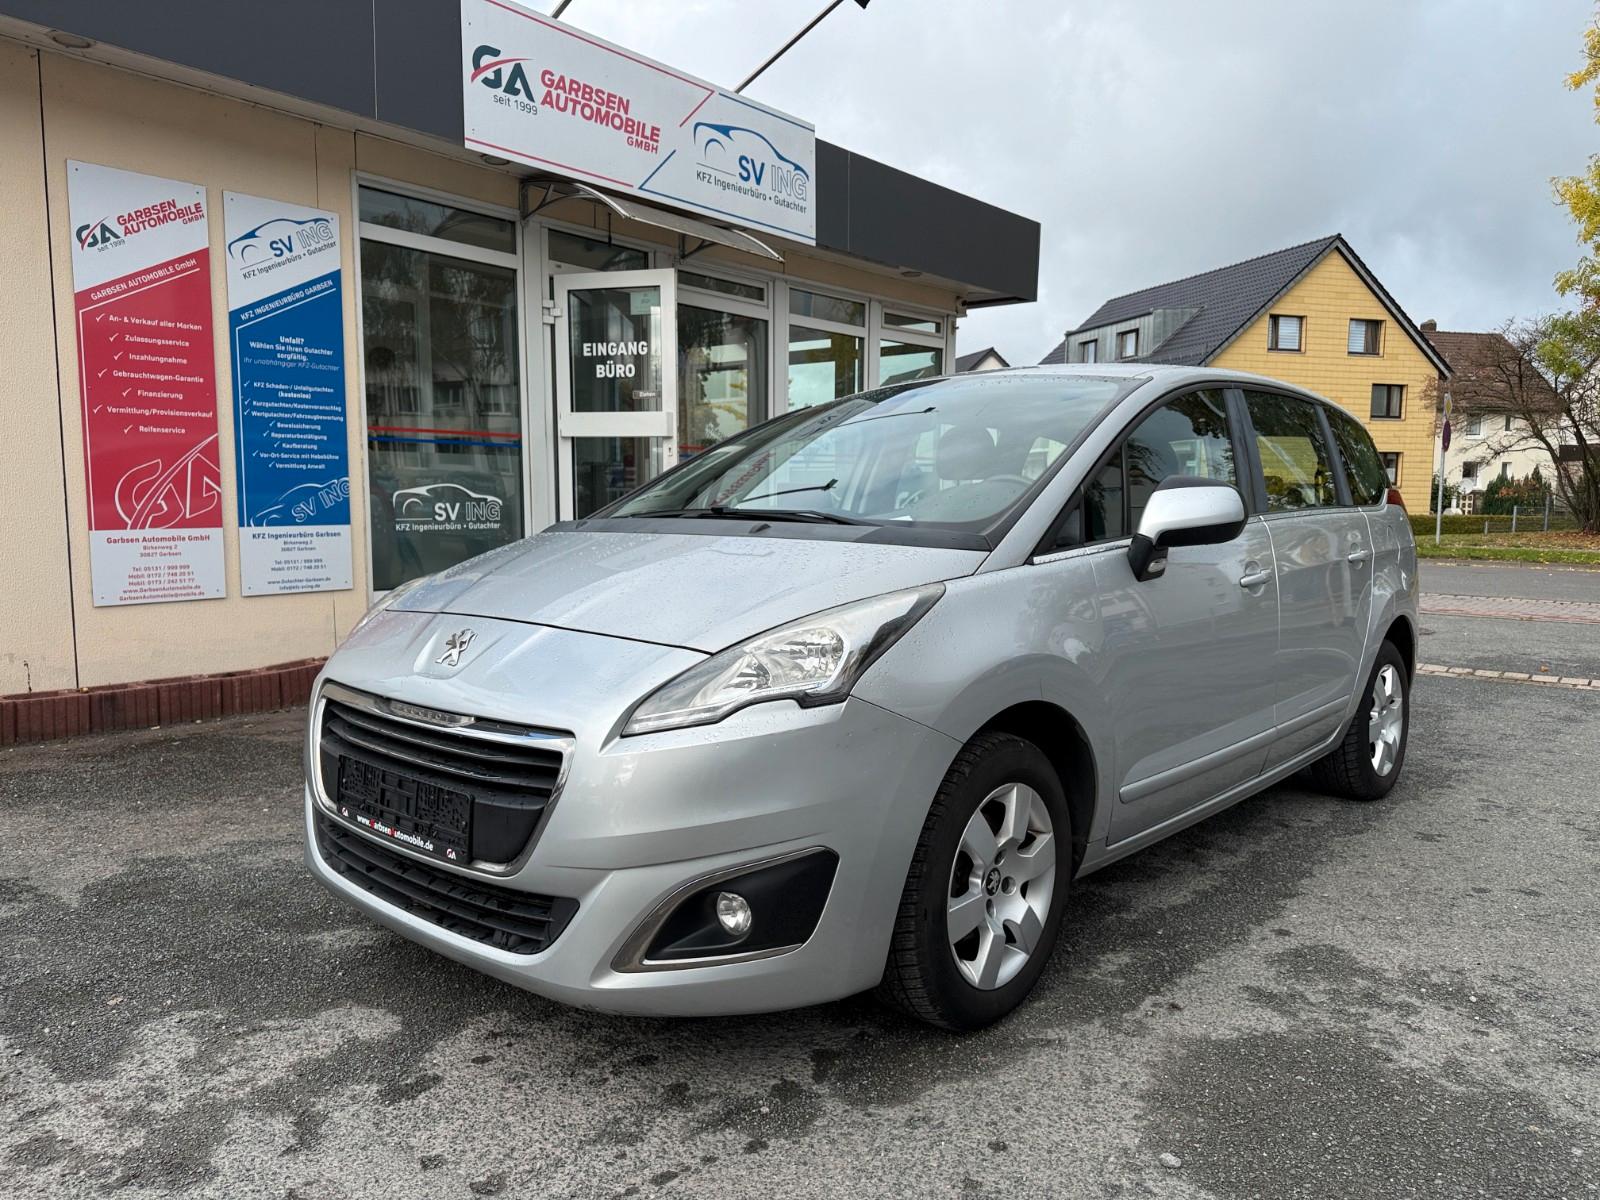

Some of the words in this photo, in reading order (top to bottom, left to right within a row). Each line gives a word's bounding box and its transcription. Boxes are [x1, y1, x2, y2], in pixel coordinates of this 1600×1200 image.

[540, 69, 630, 115] GARBSEN
[493, 94, 511, 108] seit
[514, 100, 538, 115] 1999
[540, 90, 661, 143] AUTOMOBILE
[626, 136, 659, 154] GMBH
[738, 155, 765, 186] SV
[770, 164, 807, 202] ING
[696, 170, 712, 185] KFZ
[714, 176, 767, 201] Ingenieurbüro
[774, 195, 807, 214] Gutachter
[117, 199, 176, 226] GARBSEN
[123, 202, 203, 237] AUTOMOBILE
[182, 213, 205, 225] GMBH
[97, 244, 109, 253] seit
[110, 239, 126, 249] 1999
[269, 235, 293, 258] SV
[296, 222, 334, 249] ING
[242, 269, 257, 280] KFZ
[257, 254, 303, 276] Ingenieurbüro
[307, 241, 337, 257] Gutachter
[90, 284, 127, 300] GARBSEN
[128, 265, 173, 288] AUTOMOBILE
[175, 258, 197, 271] GmbH
[240, 311, 255, 321] KFZ
[254, 290, 305, 315] INGENIEURBÜRO
[305, 280, 333, 295] GARBSEN
[130, 317, 158, 327] Verkauf
[159, 320, 175, 328] aller
[176, 321, 202, 331] Marken
[124, 334, 190, 347] Zulassungsservice
[249, 341, 274, 350] Wählen
[286, 345, 303, 353] Ihren
[303, 347, 334, 356] Gutachter
[279, 336, 305, 345] Unfall?
[582, 341, 649, 357] EINGANG
[129, 353, 188, 365] Inzahlungnahme
[112, 370, 204, 383] Gebrauchtwagen-Garantie
[595, 360, 636, 378] BÜRO
[137, 389, 184, 400] Finanzierung
[107, 405, 213, 419] Vermittlung/Provisionsverkauf
[139, 425, 186, 434] Reifenservice
[291, 496, 317, 523] SV
[434, 502, 460, 521] SV
[465, 501, 501, 521] ING
[252, 532, 266, 540] KFZ
[267, 531, 314, 540] Ingenieurbüro
[395, 523, 411, 532] KFZ
[411, 522, 462, 533] Ingenieurbüro
[468, 521, 501, 530] Gutachter
[106, 536, 140, 545] Garbsen
[141, 534, 187, 544] Automobile
[187, 533, 210, 542] GmbH
